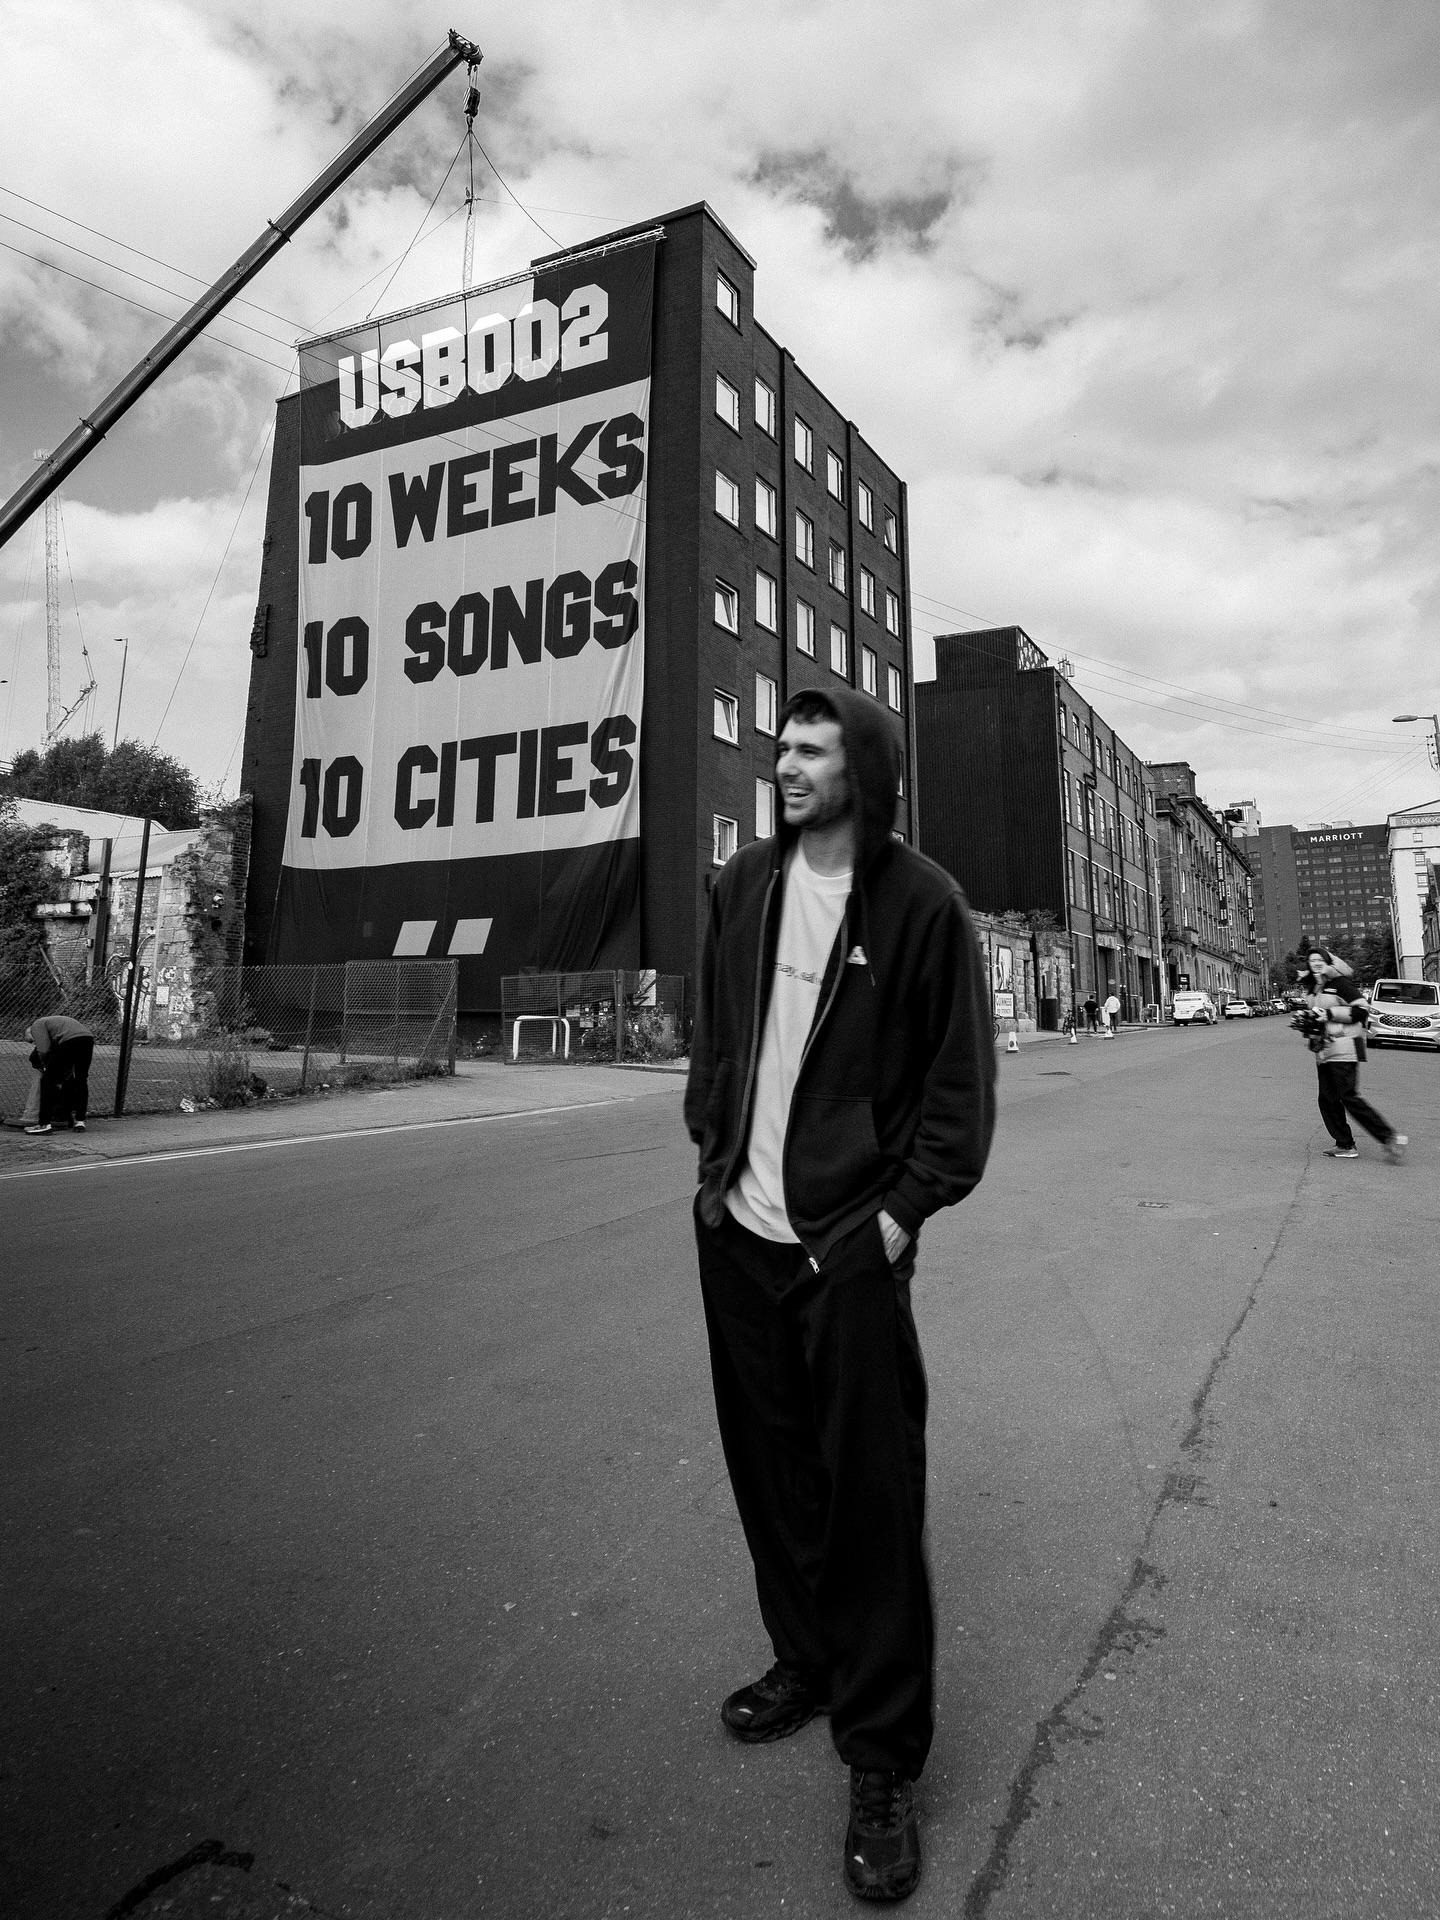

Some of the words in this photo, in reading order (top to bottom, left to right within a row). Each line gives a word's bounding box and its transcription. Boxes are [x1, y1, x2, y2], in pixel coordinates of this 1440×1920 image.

[338, 283, 608, 429] USB002
[304, 482, 371, 564] 10
[388, 412, 645, 548] WEEKS
[304, 616, 369, 699] 10
[404, 559, 639, 686] SONGS
[300, 755, 363, 839] 10
[396, 715, 636, 831] CITIES
[1310, 832, 1364, 843] MARRIOTT
